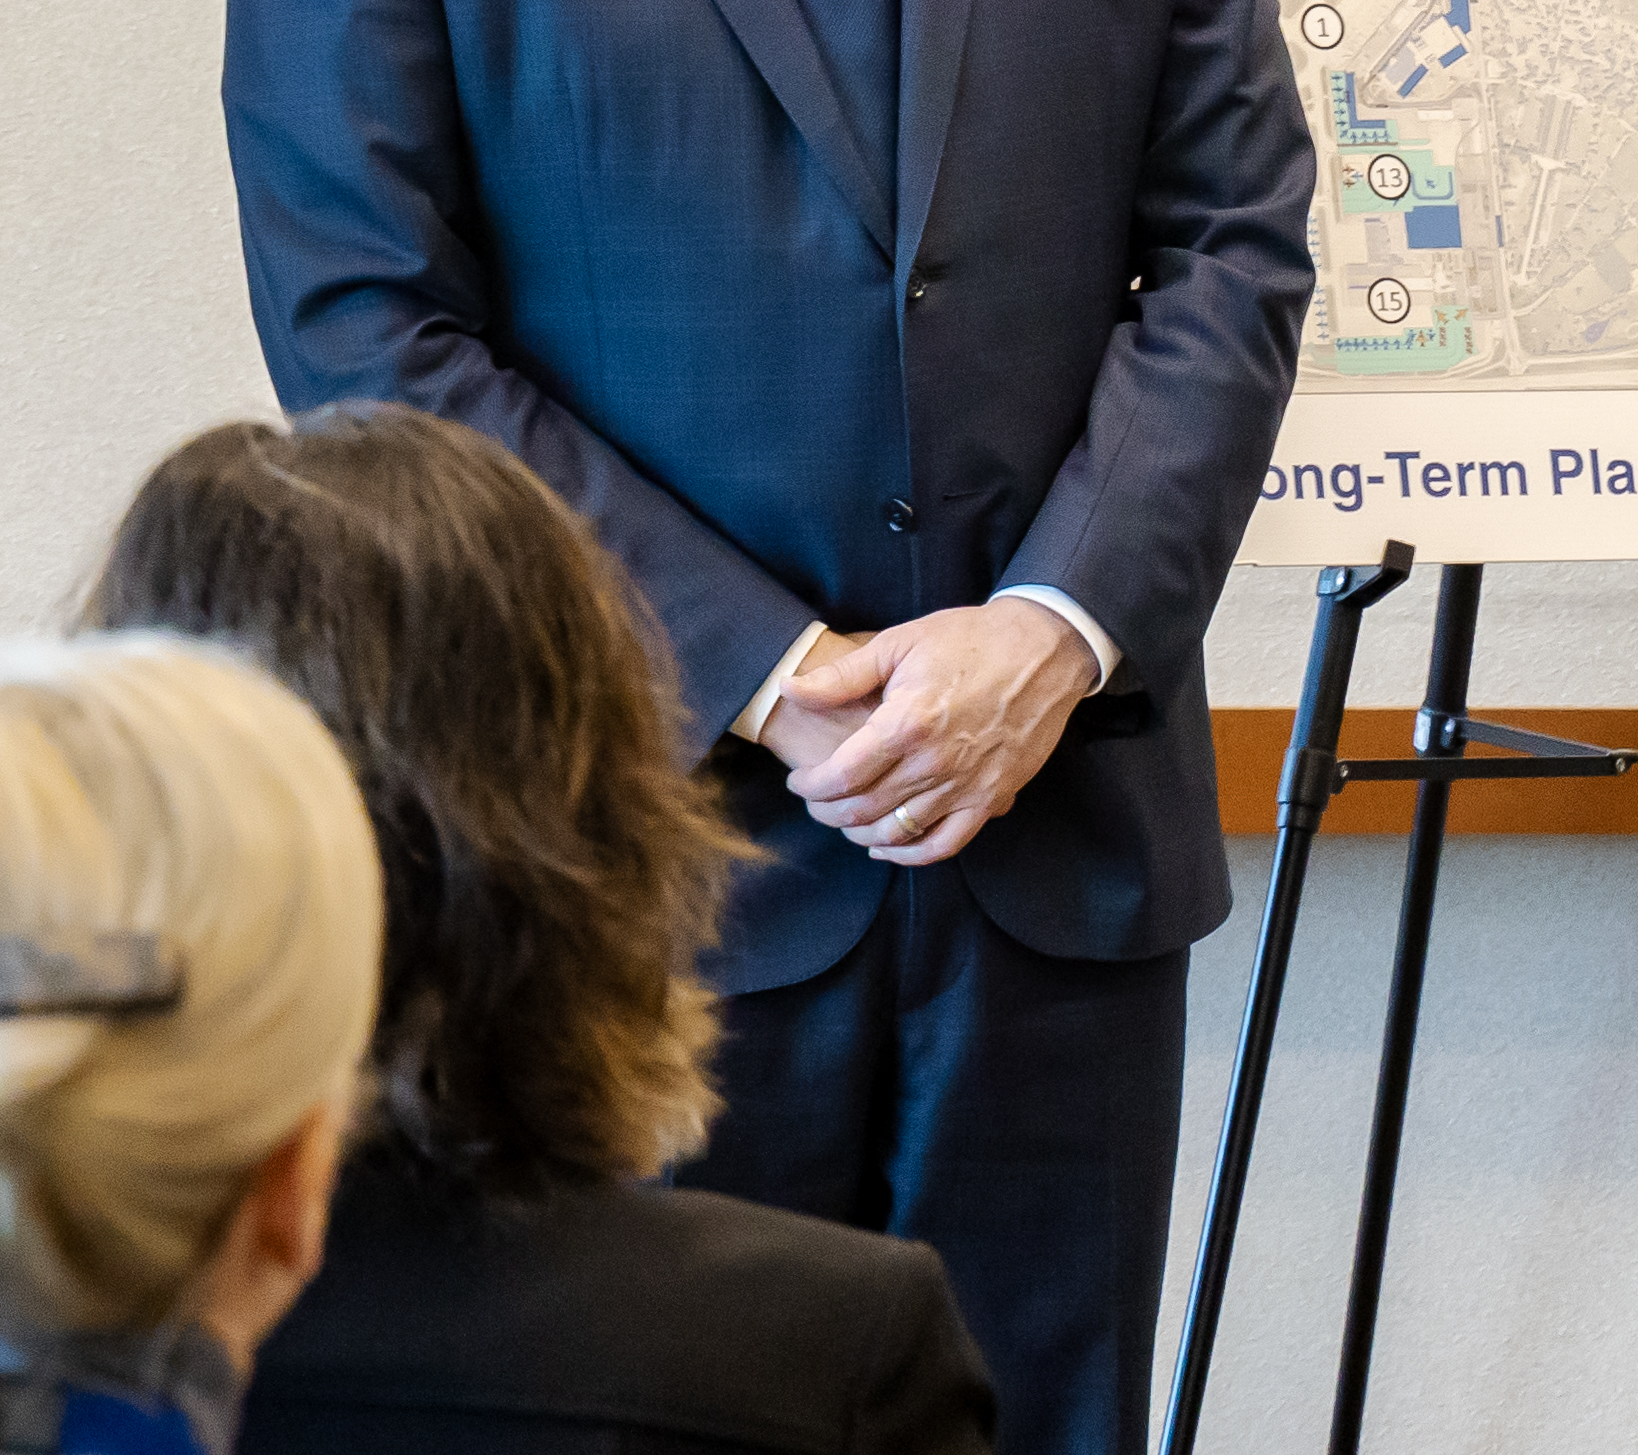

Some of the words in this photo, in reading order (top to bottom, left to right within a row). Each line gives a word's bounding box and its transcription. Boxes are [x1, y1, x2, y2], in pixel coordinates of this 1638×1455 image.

[1317, 17, 1330, 38] 1
[1376, 167, 1403, 188] 13
[1376, 291, 1403, 312] 15
[1260, 450, 1528, 513] ong-Term
